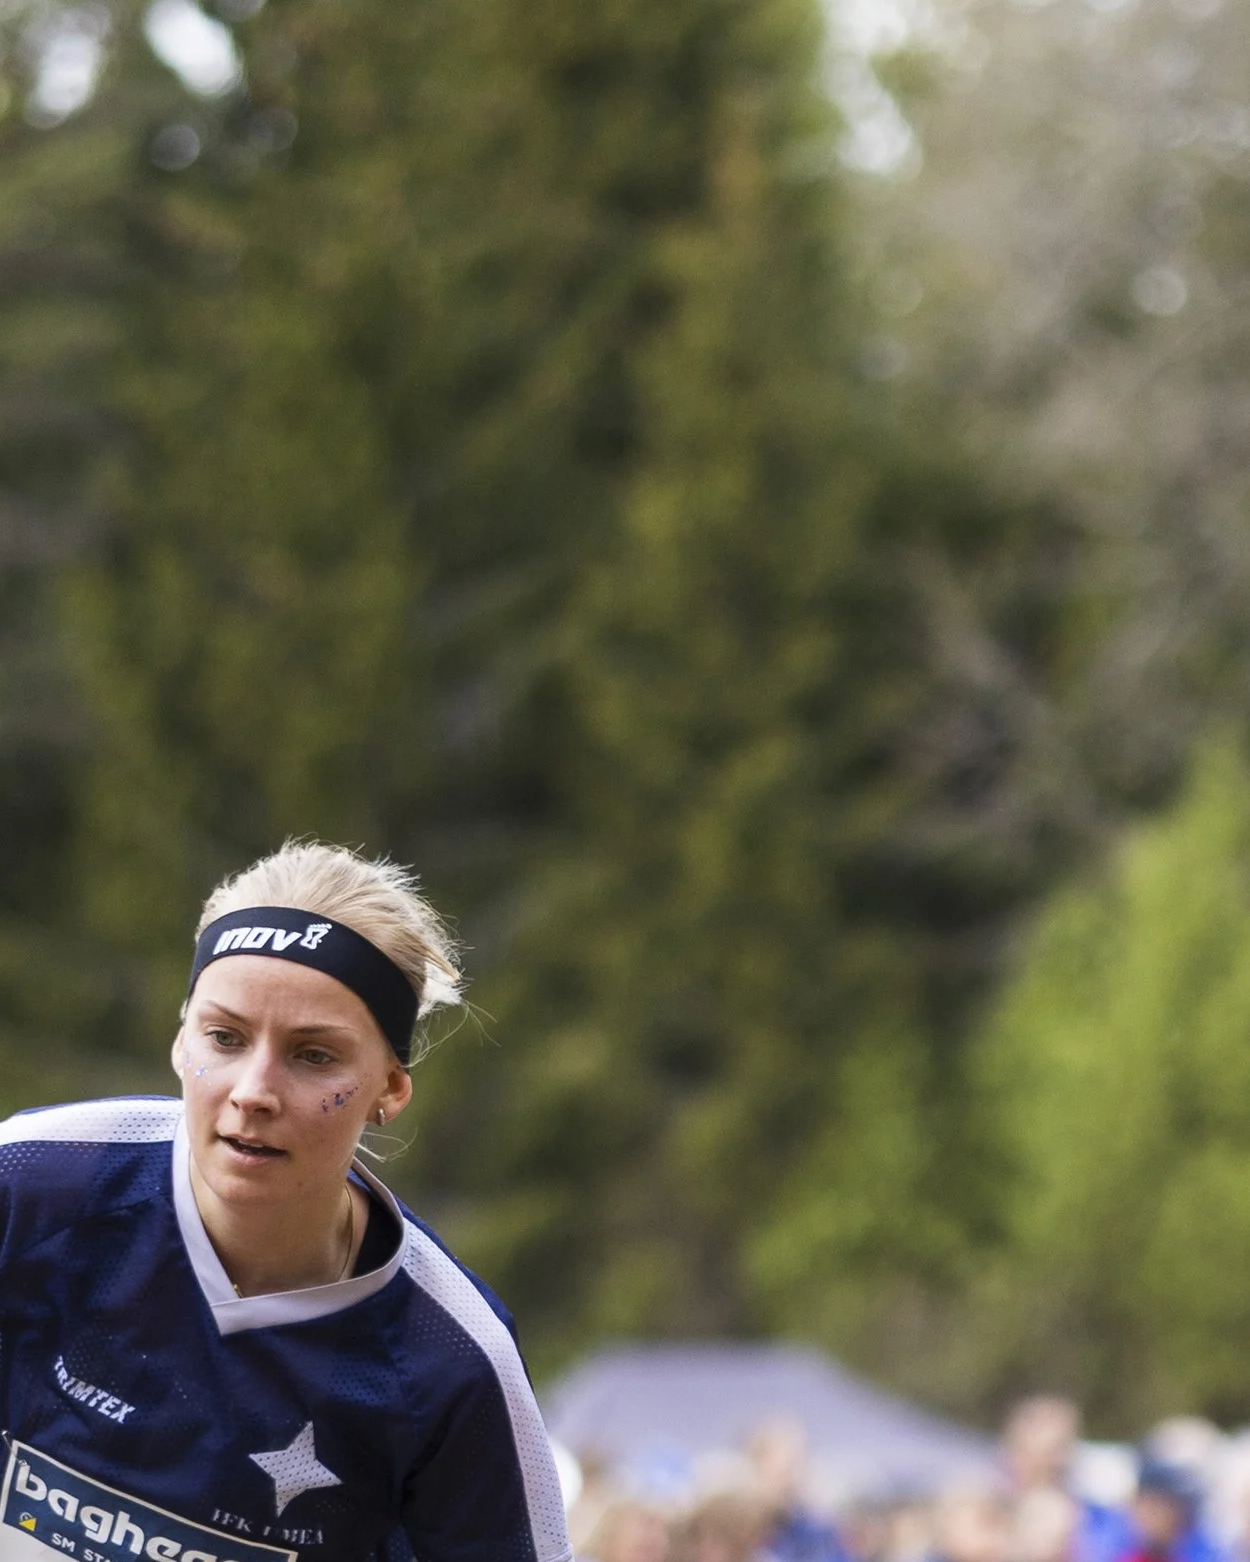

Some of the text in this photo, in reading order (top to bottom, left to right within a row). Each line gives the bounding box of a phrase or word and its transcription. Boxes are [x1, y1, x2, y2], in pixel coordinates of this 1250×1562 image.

[54, 1355, 136, 1424] TRIMTEX
[212, 1508, 252, 1533] IFK
[52, 1533, 76, 1552] SM
